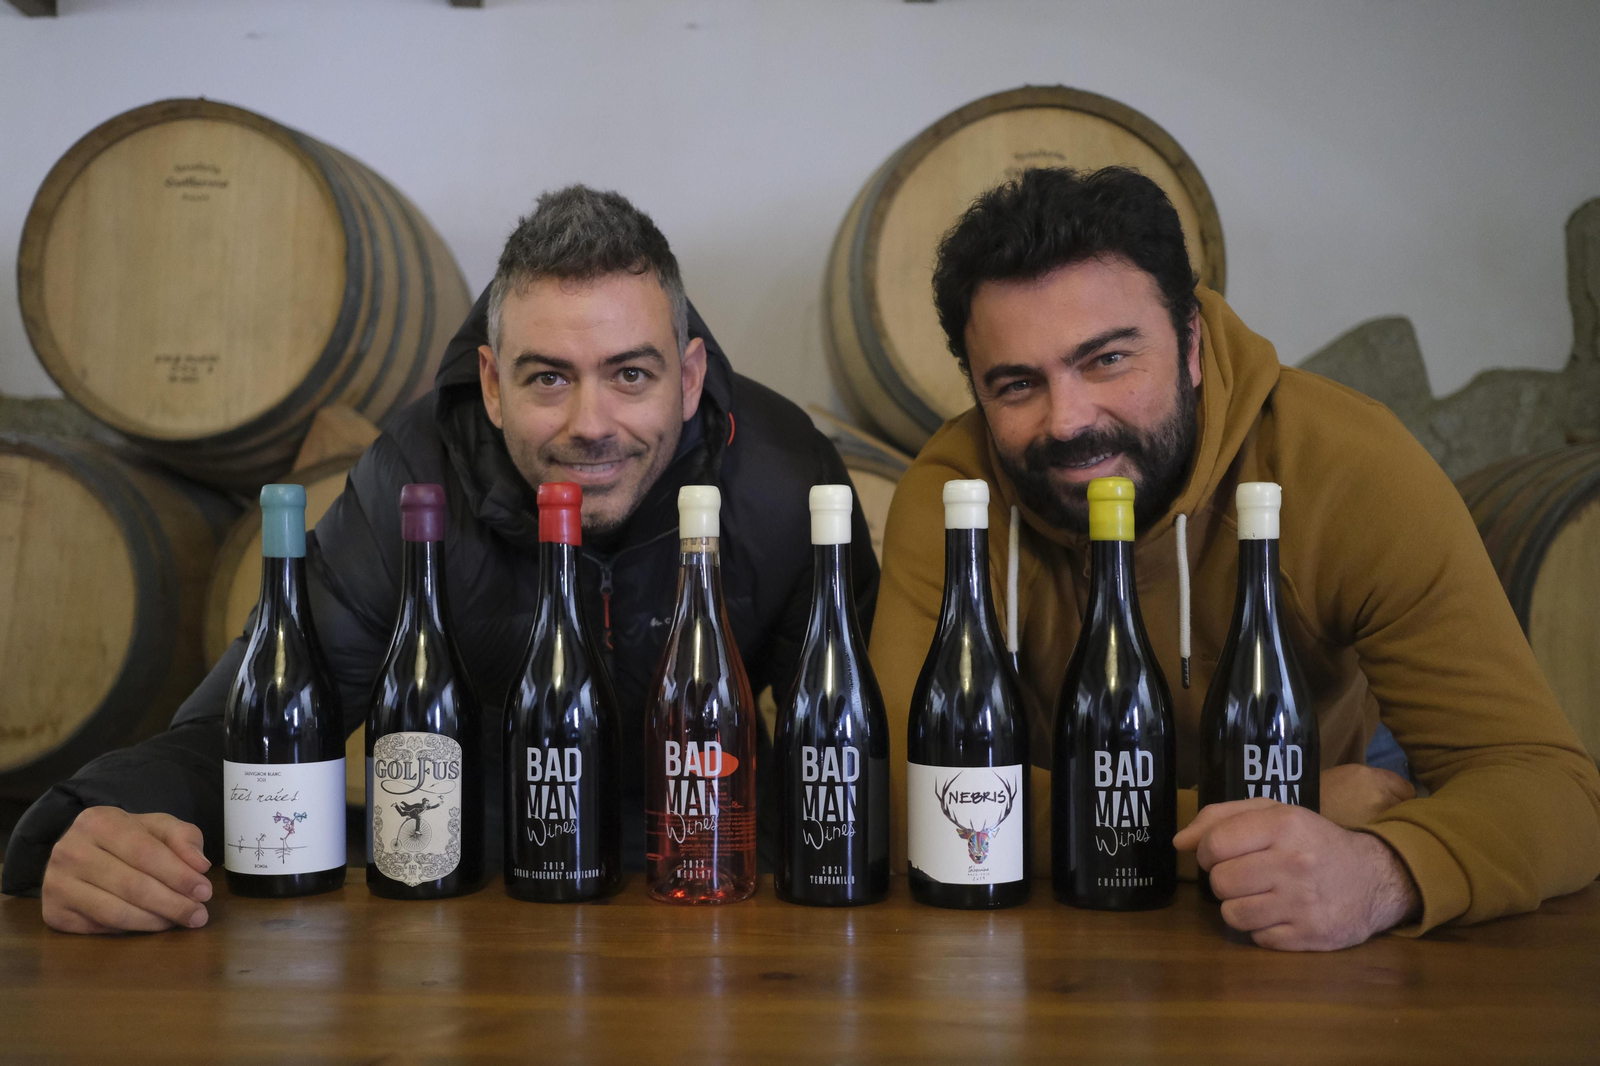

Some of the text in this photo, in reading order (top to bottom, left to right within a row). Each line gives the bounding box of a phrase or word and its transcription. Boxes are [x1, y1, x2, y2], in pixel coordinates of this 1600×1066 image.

[375, 757, 460, 794] GOLFUS
[526, 747, 582, 783] BAD
[665, 740, 722, 777] BAD
[802, 745, 860, 783] BAD
[1094, 750, 1154, 788] BAD
[1243, 744, 1303, 782] BAD
[230, 783, 253, 802] tres
[527, 784, 580, 820] MAN
[666, 779, 719, 816] MAN
[802, 785, 857, 822] MAN
[948, 790, 1007, 804] NEBRIS
[1095, 790, 1151, 828] MAN
[526, 813, 579, 847] Wines
[665, 810, 719, 844] Wines
[802, 815, 856, 850] Wines
[1095, 821, 1151, 857] Wines
[543, 861, 565, 870] 2019
[565, 868, 600, 880] SAUVIGNON
[676, 869, 712, 879] MERLOT
[682, 859, 705, 869] 2022
[809, 875, 856, 885] TEMPRANILLO
[821, 865, 843, 875] 2021
[1115, 867, 1138, 877] 2021
[1097, 876, 1154, 888] CHARDONNAY
